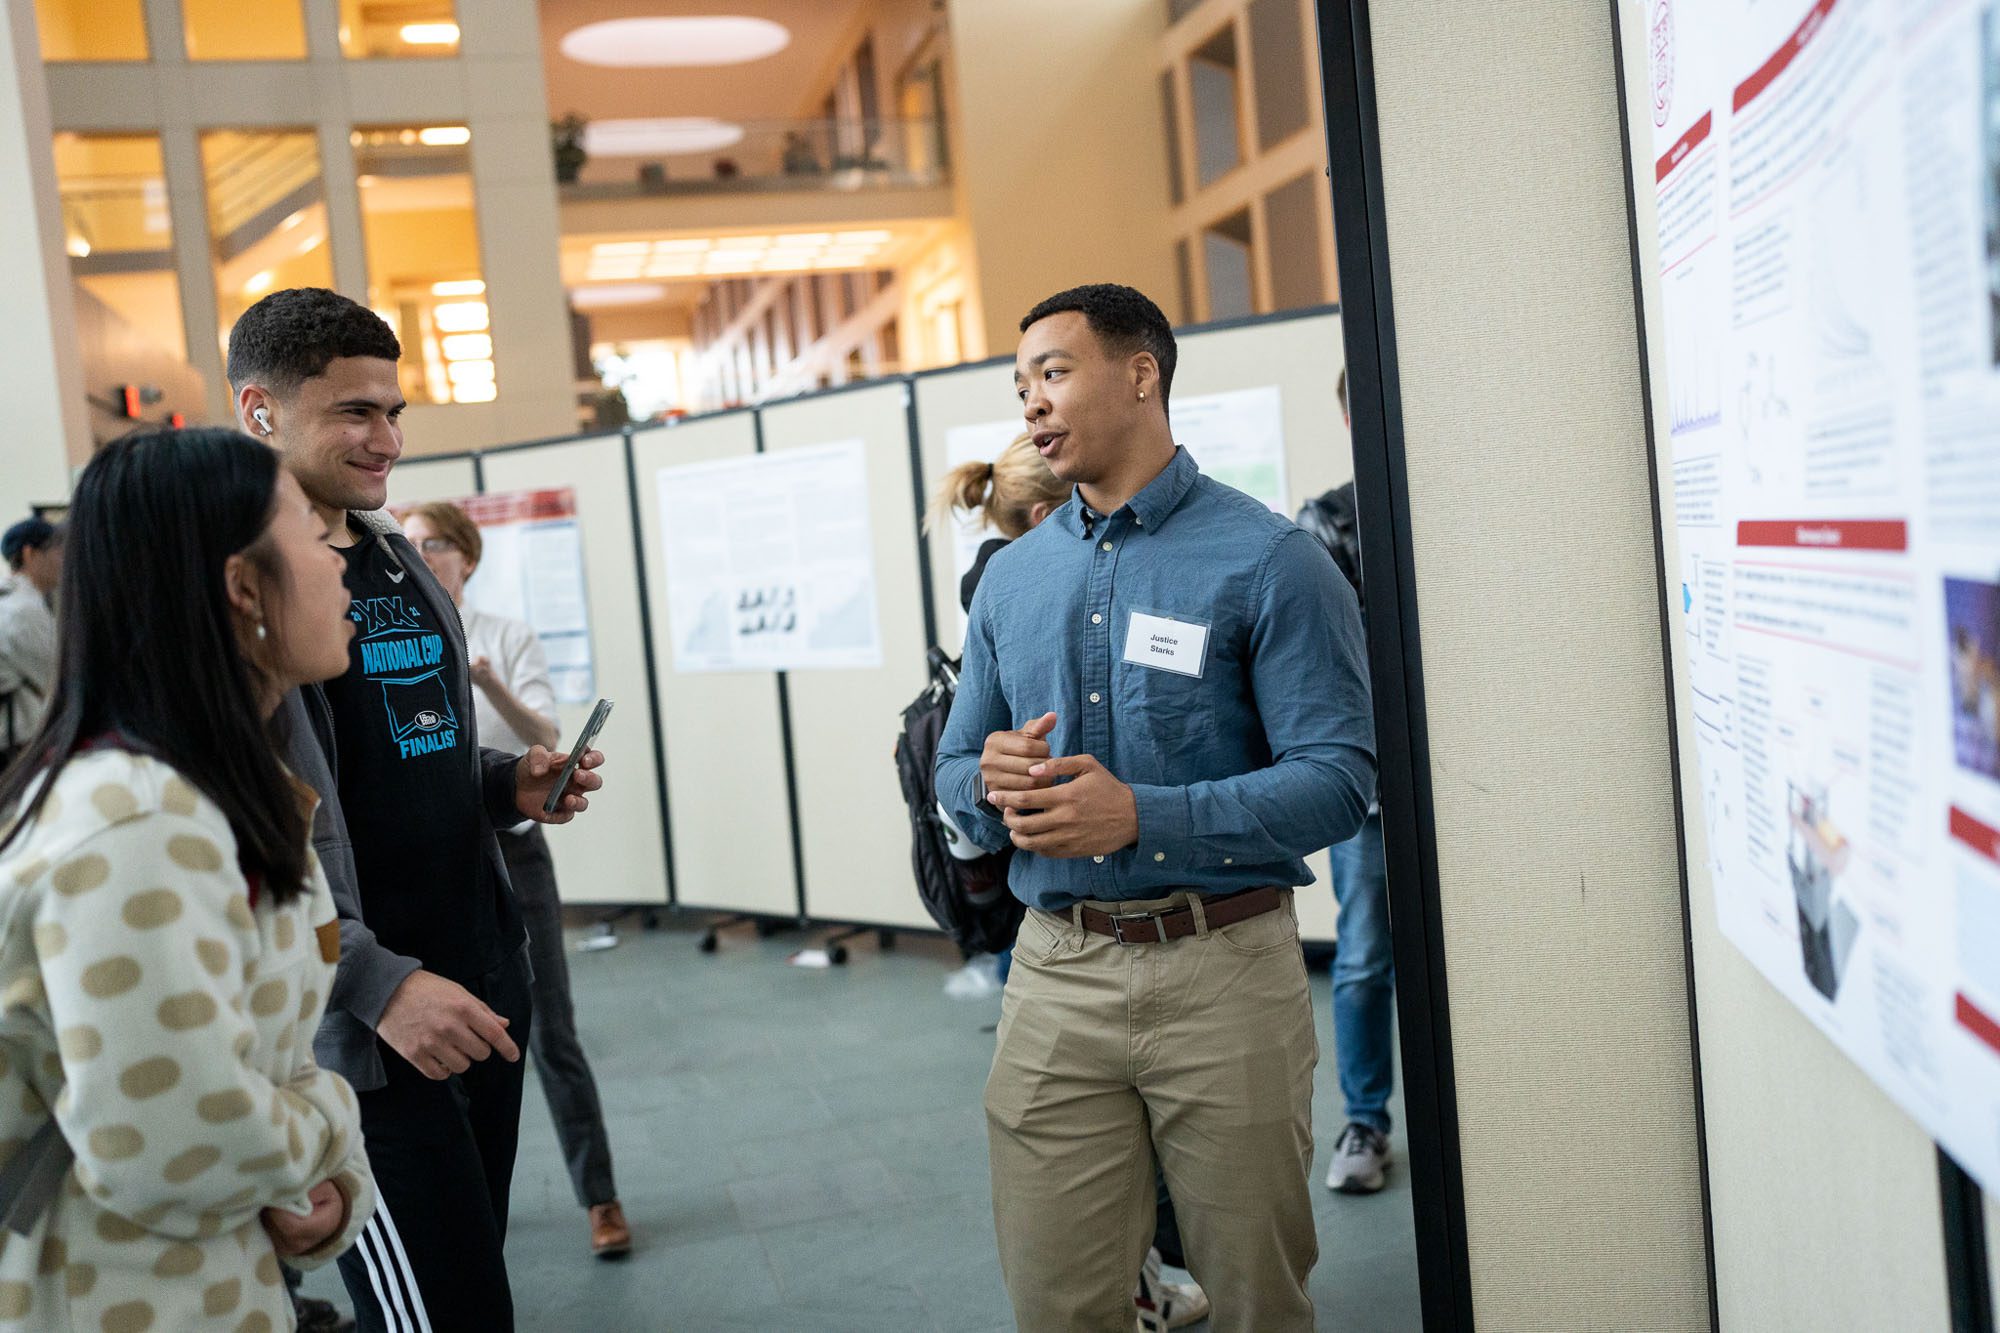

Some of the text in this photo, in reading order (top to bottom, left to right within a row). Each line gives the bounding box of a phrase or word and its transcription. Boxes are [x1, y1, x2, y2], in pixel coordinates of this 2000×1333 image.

[408, 606, 421, 617] 21
[1150, 634, 1178, 645] Justice
[361, 634, 443, 675] NATIONAL CUP
[1150, 645, 1174, 655] Starks
[400, 730, 456, 759] FINALIST
